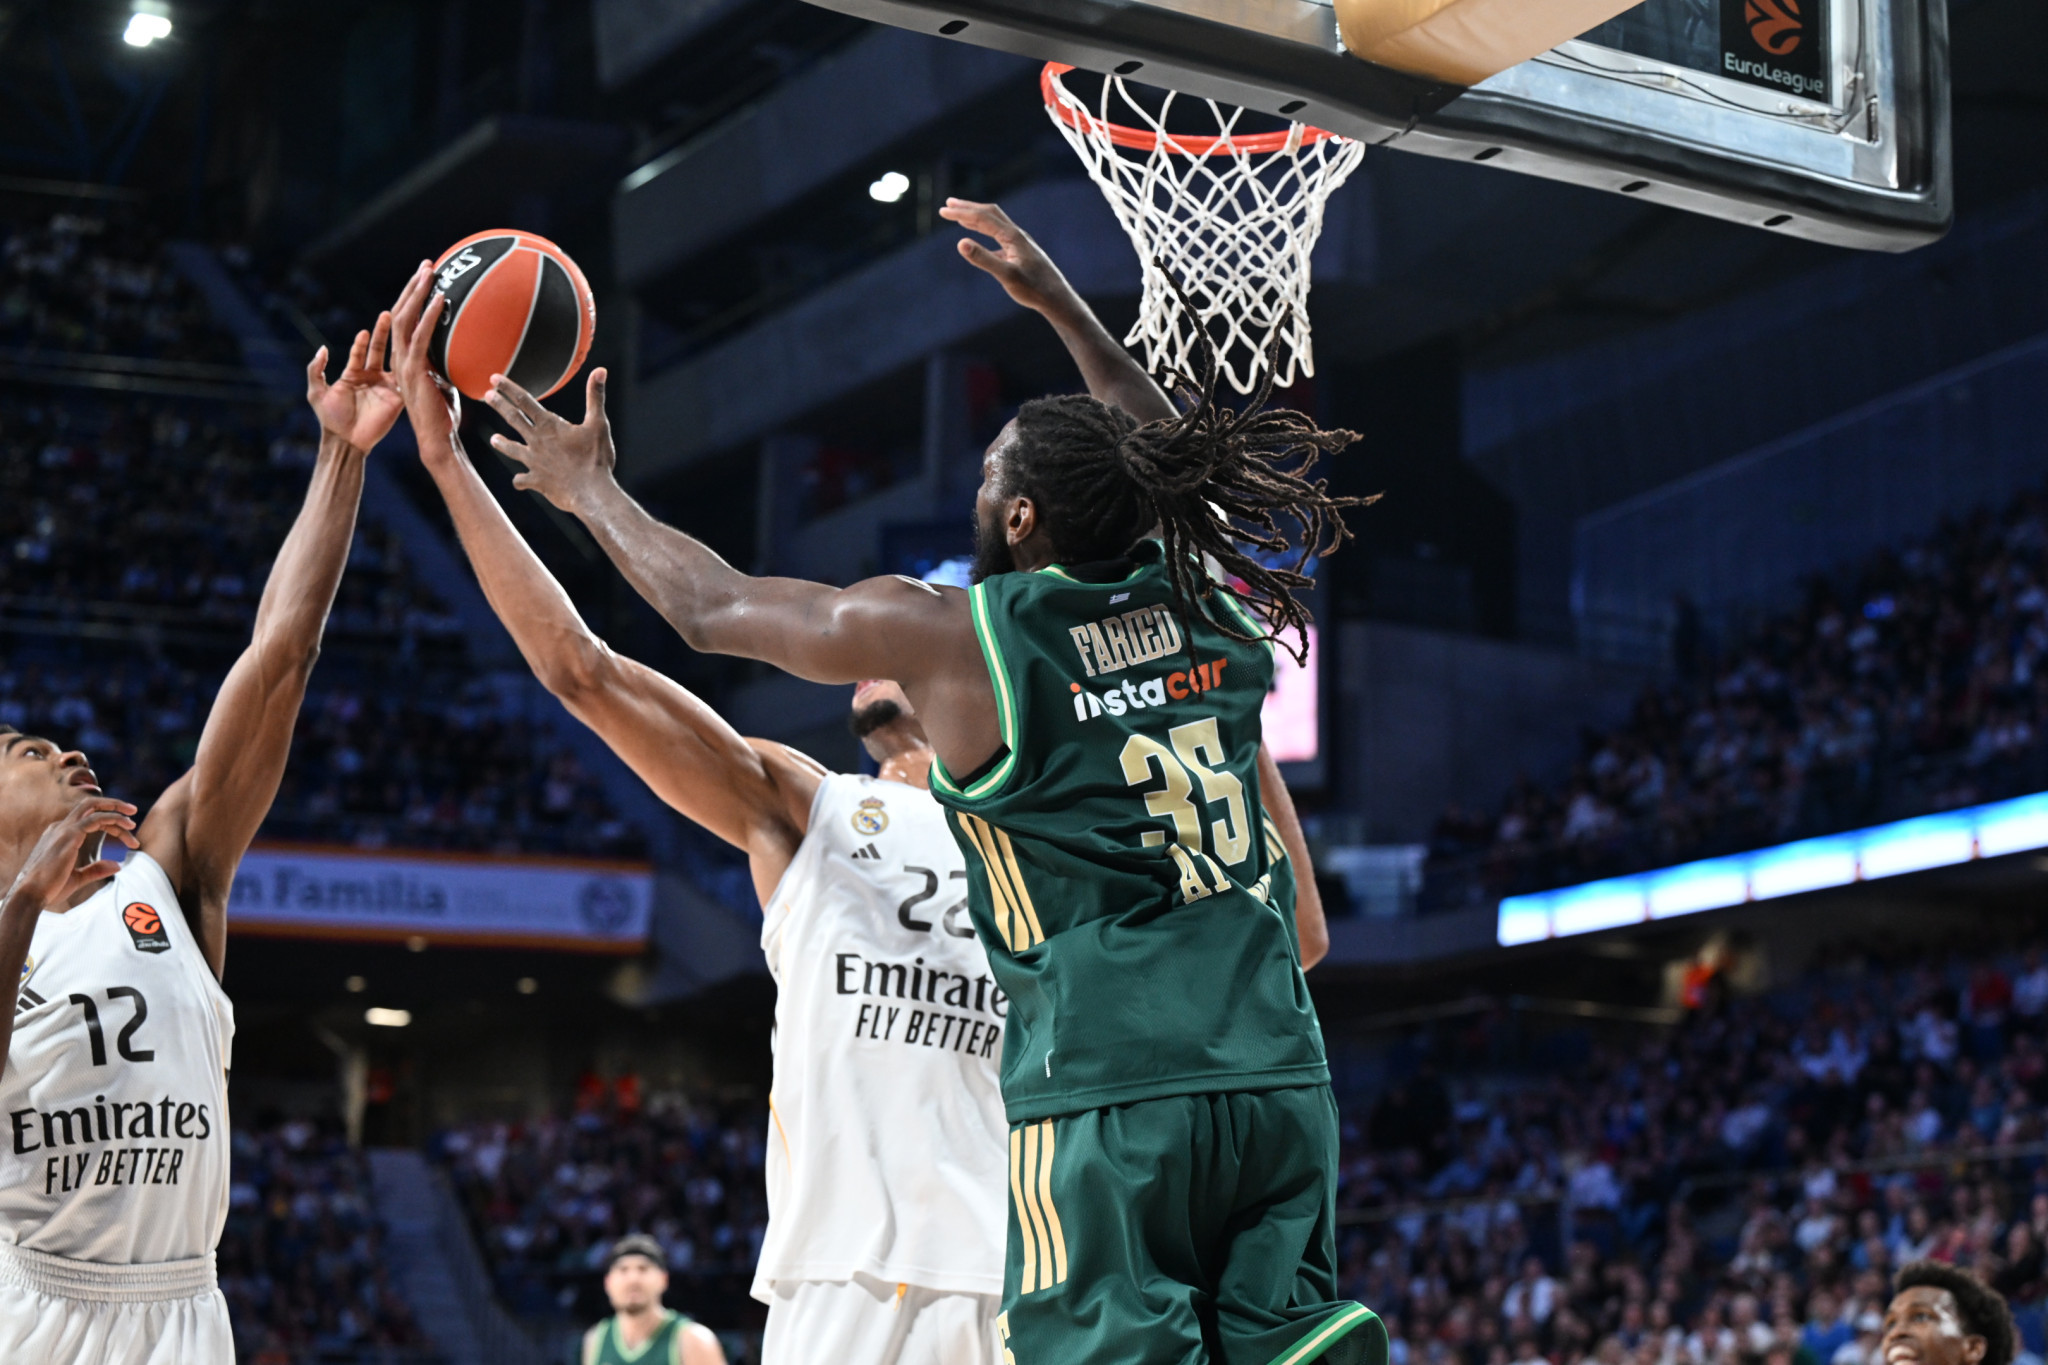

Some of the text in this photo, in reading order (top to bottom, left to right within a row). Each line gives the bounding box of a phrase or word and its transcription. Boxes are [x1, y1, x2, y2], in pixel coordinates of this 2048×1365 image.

[1724, 52, 1824, 93] EuroLeague
[1069, 603, 1182, 677] FARIED
[1069, 658, 1228, 722] instacar
[1119, 716, 1250, 866] 35
[897, 865, 976, 939] 22
[836, 953, 1008, 1019] Emirate
[68, 986, 155, 1066] 12
[855, 1003, 1000, 1059] FLY BETTER
[9, 1094, 211, 1155] Emirates
[45, 1147, 184, 1195] FLY BETTER
